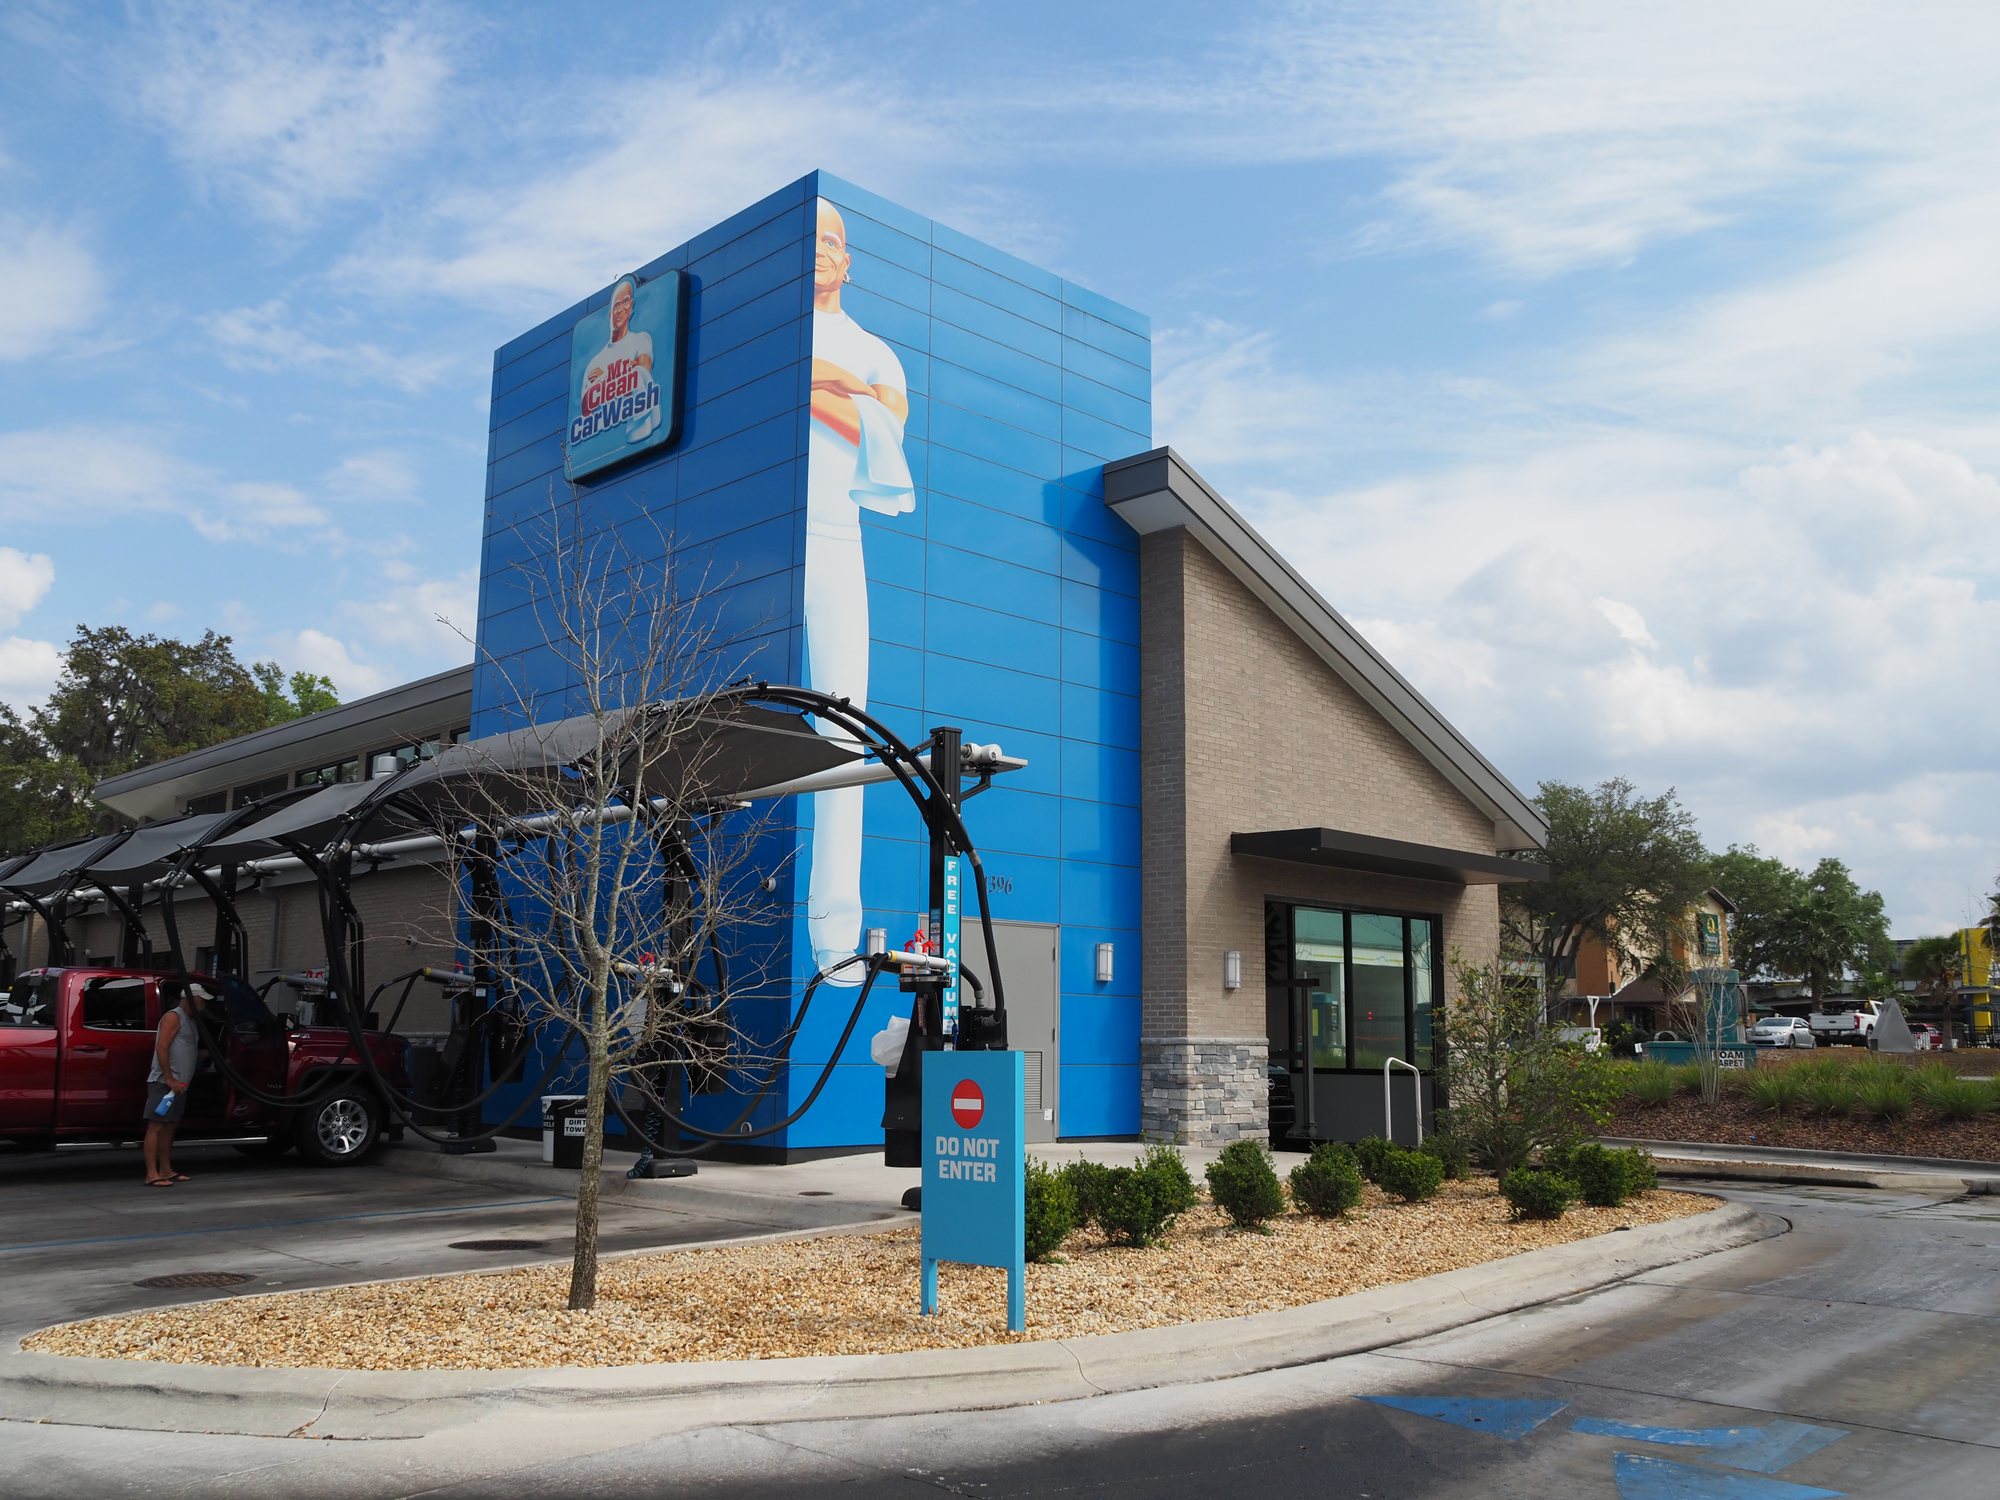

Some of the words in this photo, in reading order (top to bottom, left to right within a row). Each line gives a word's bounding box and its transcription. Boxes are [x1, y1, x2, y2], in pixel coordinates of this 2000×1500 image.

[606, 358, 632, 382] Mr.
[585, 370, 638, 411] Clean
[570, 381, 659, 444] CarWash
[947, 861, 957, 914] FREE
[936, 1136, 959, 1156] DO
[963, 1137, 1000, 1159] NOT
[939, 1159, 996, 1182] ENTER
